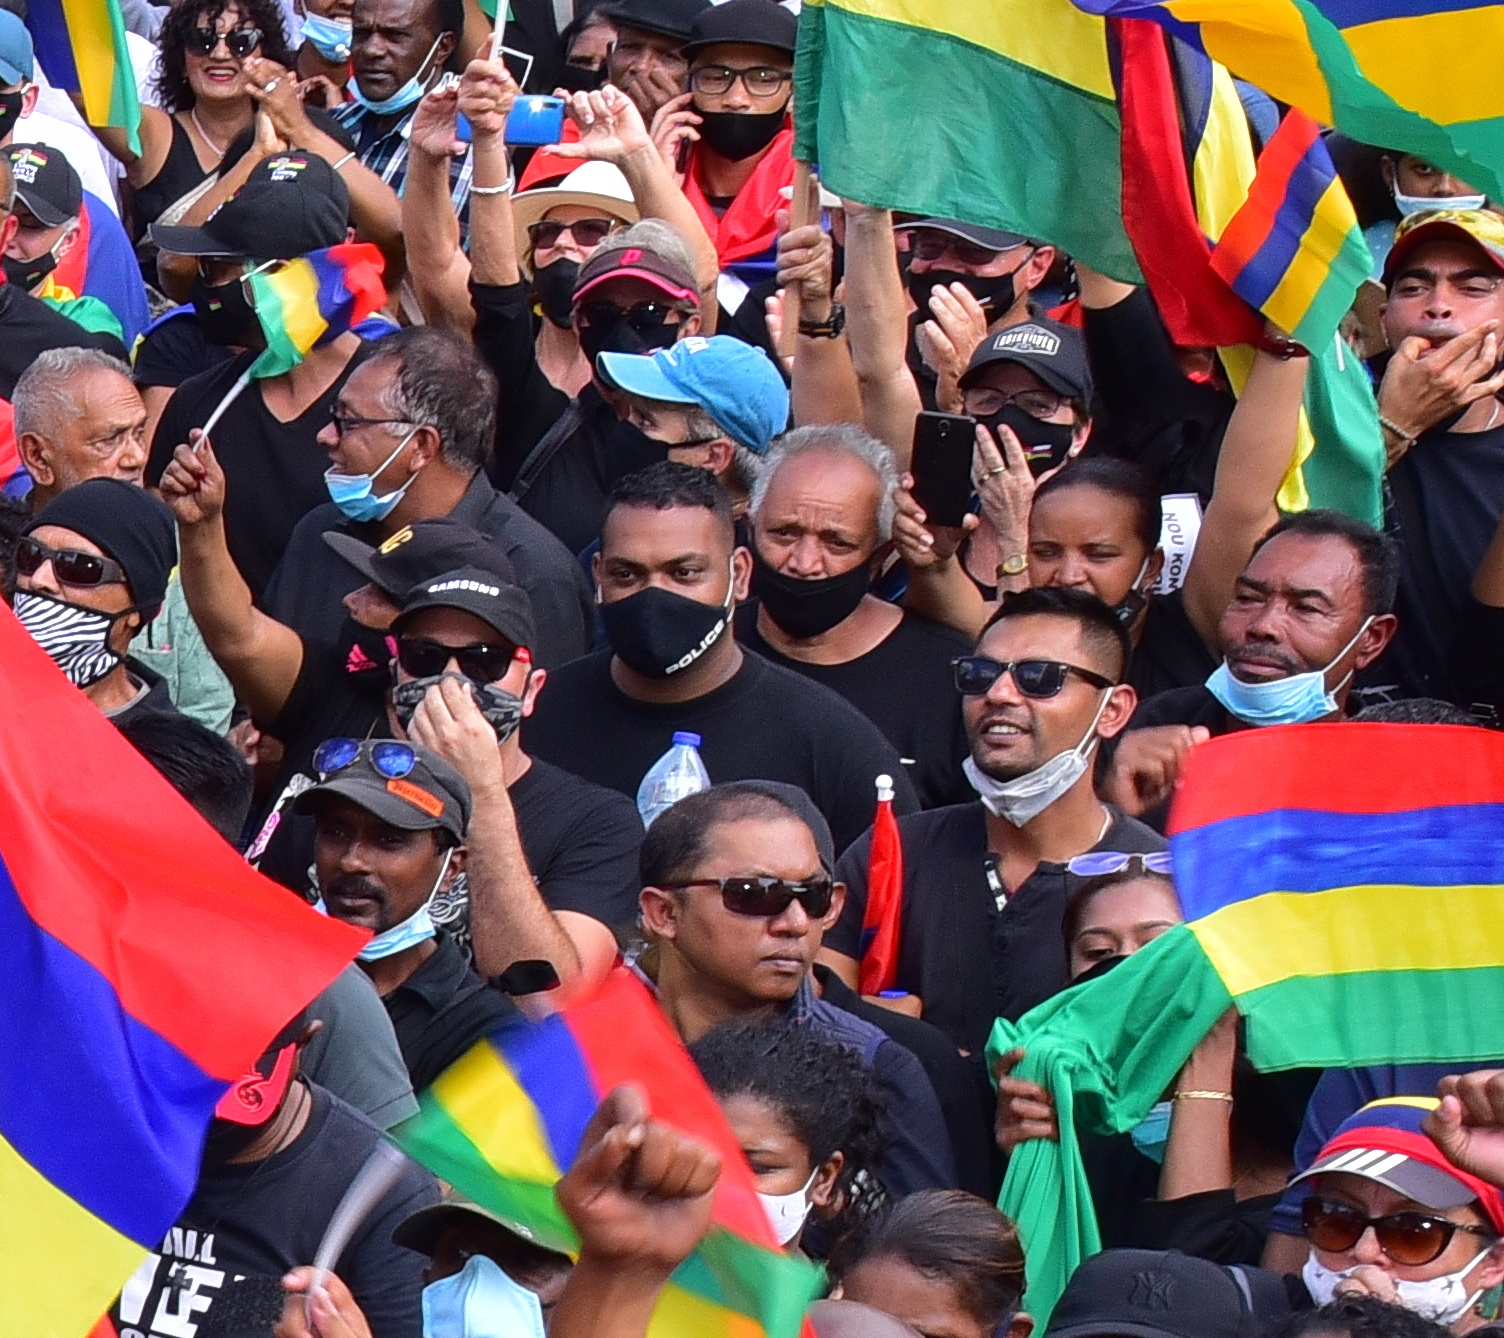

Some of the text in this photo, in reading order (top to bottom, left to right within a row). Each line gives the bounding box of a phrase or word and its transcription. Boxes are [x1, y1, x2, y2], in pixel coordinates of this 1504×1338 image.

[1163, 513, 1185, 546] NOU
[428, 580, 500, 596] SAMSUNG
[665, 618, 725, 675] POLICE
